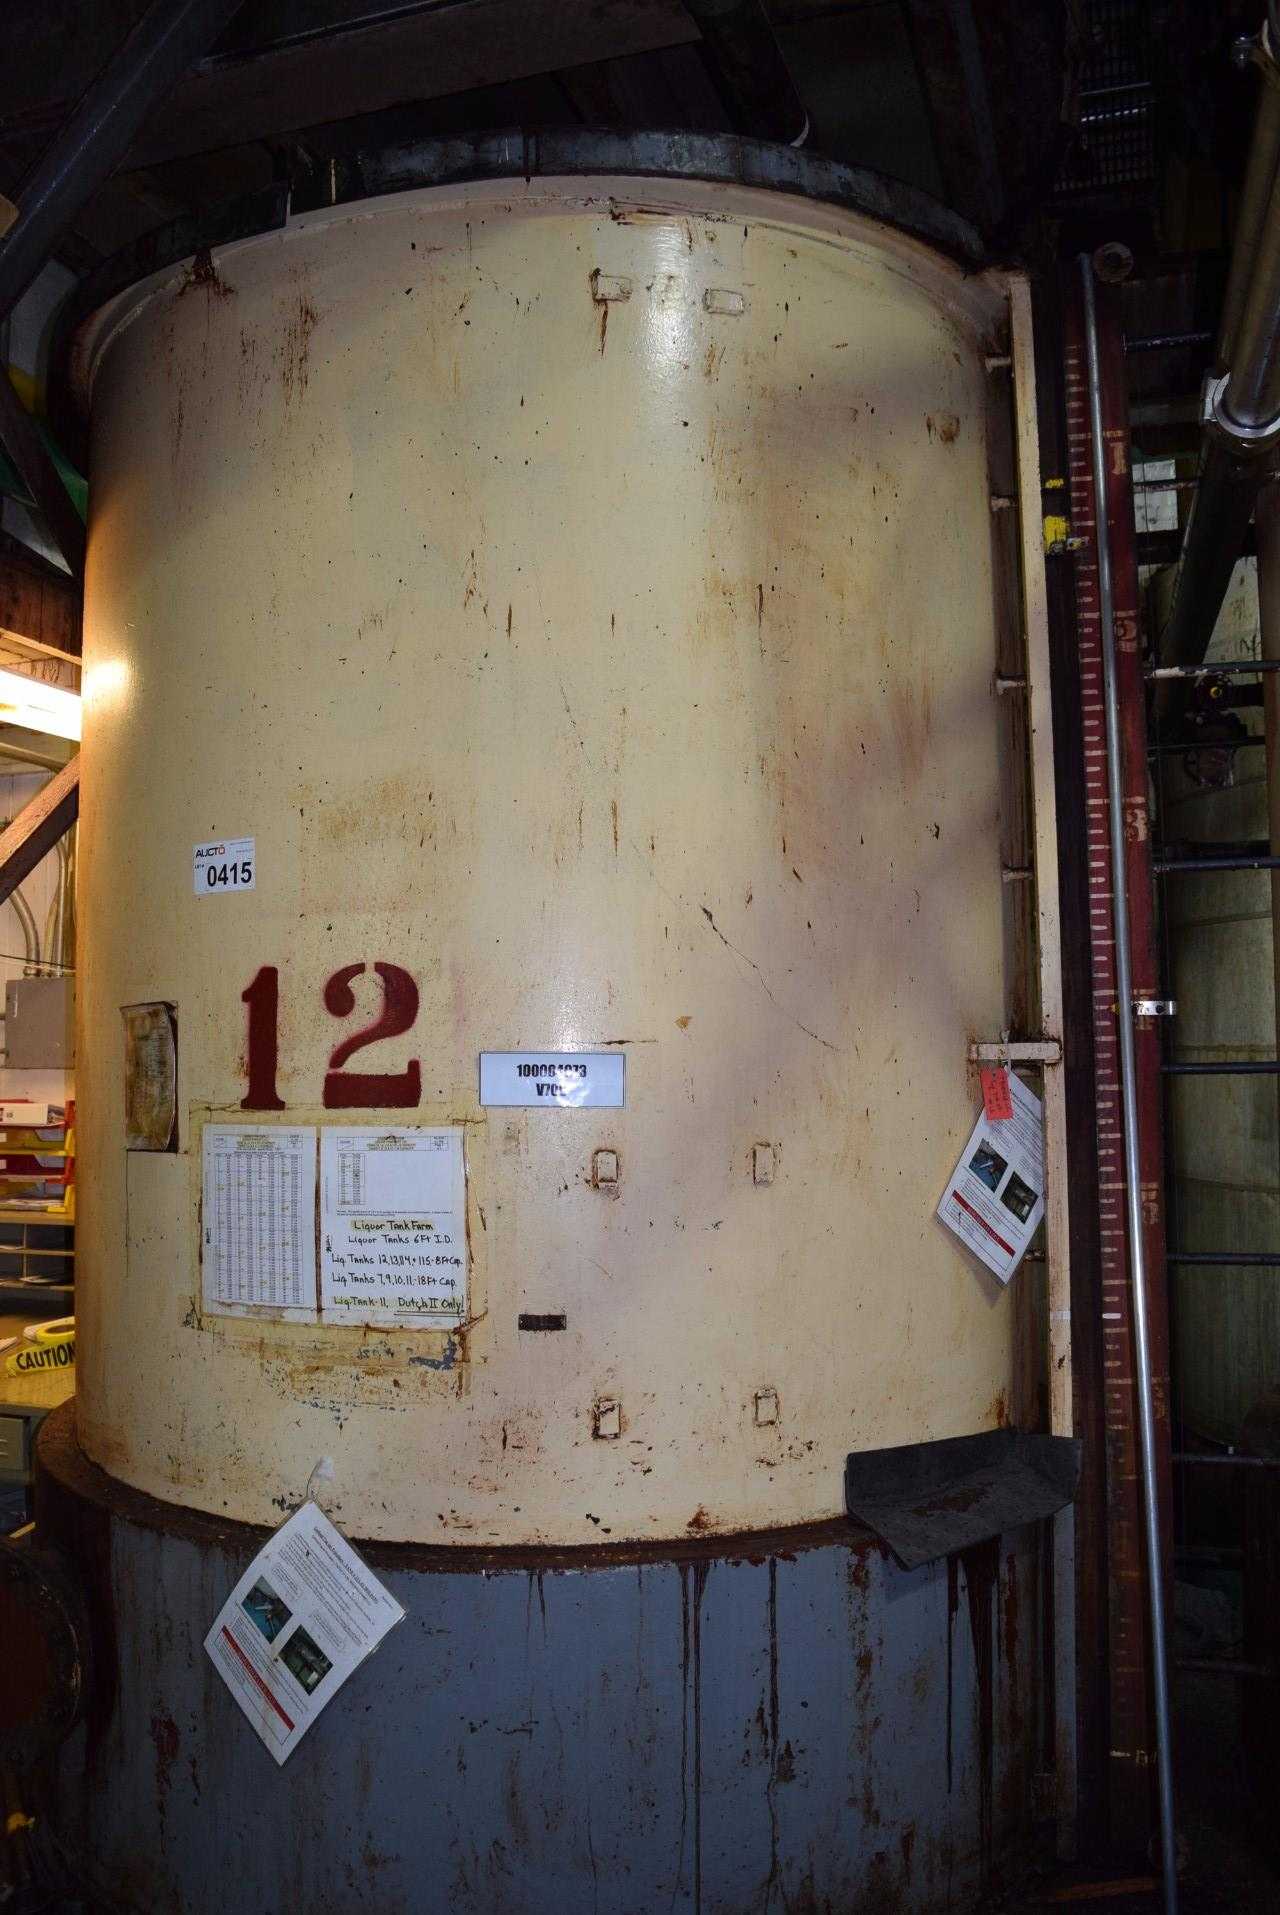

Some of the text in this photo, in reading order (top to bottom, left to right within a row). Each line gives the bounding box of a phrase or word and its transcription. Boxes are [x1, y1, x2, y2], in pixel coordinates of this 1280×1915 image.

[207, 862, 252, 887] 0415
[240, 961, 422, 1111] 12
[353, 1220, 434, 1232] Liquor Tank Farm
[348, 1235, 378, 1246] Liquor
[381, 1234, 410, 1244] Tanks
[433, 1234, 454, 1244] I.D.
[346, 1254, 375, 1265] Tanks
[348, 1272, 376, 1284] Tanks
[398, 1297, 428, 1311] Dutch
[440, 1295, 465, 1315] Only!
[15, 1341, 77, 1371] CAUTION
